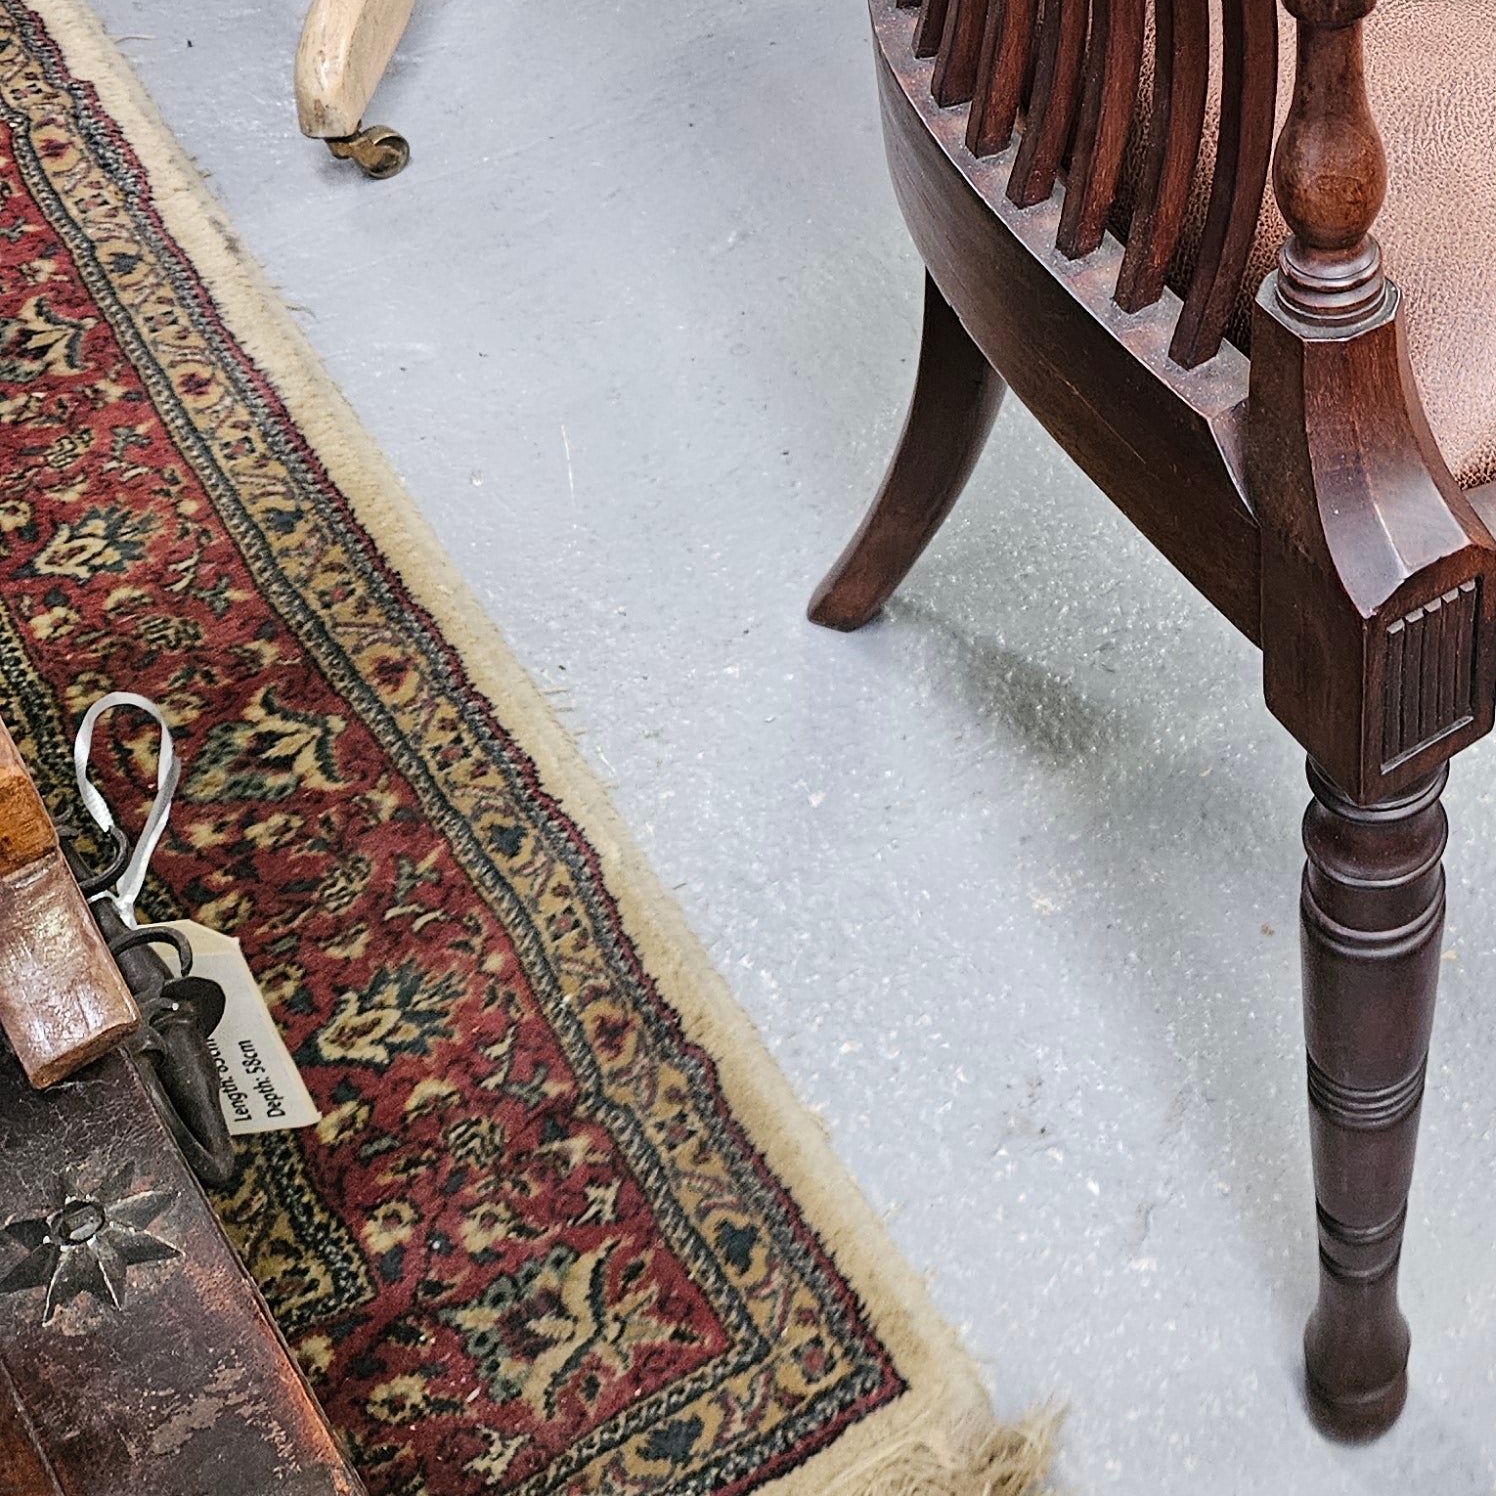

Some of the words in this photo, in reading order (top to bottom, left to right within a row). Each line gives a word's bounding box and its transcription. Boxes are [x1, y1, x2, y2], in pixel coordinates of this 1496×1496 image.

[238, 1040, 266, 1074] 58cm
[219, 1076, 252, 1122] Length:
[253, 1077, 286, 1118] Depth:
